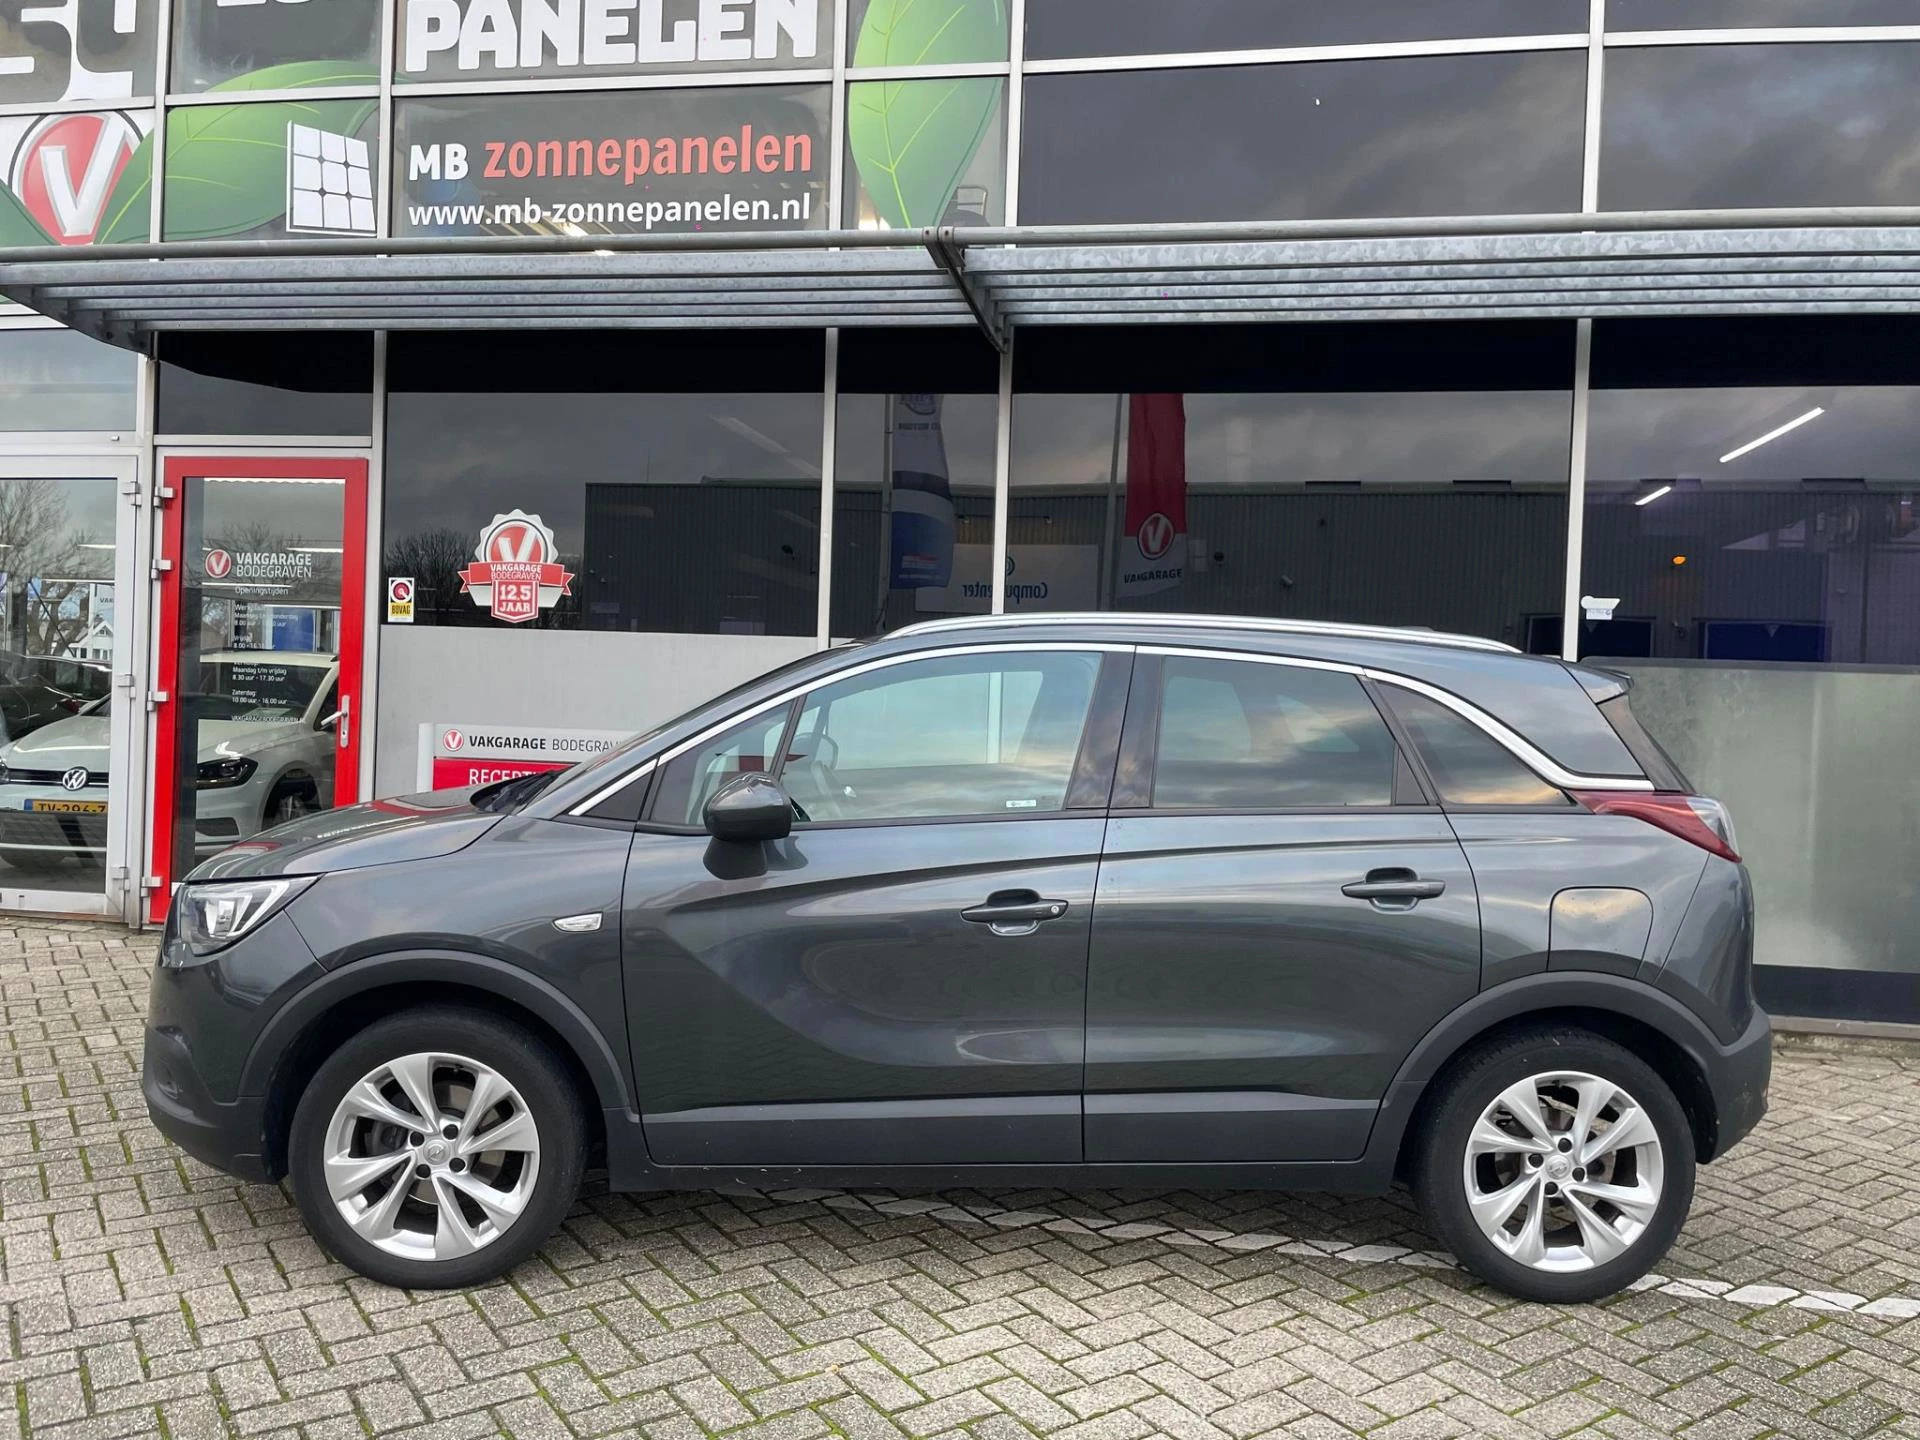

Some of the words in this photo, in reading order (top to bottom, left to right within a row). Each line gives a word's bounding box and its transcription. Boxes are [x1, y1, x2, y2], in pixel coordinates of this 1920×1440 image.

[405, 0, 817, 73] PANELEN
[409, 142, 469, 181] MB
[483, 125, 813, 186] zonnepanelen
[408, 192, 811, 229] www.mb-zonnepanelen.nl
[236, 552, 312, 566] VAKGARAGE
[236, 565, 312, 578] BODEGRAVEN
[490, 563, 542, 573] VAKGARAGE
[491, 571, 542, 581] BODEGRAVEN
[234, 587, 289, 597] Openingstijden
[391, 604, 411, 615] BOVAG
[499, 602, 531, 612] JAAR
[232, 666, 257, 675] Maandag
[469, 735, 547, 750] VAKGARAGE
[552, 738, 621, 752] BODEGRA
